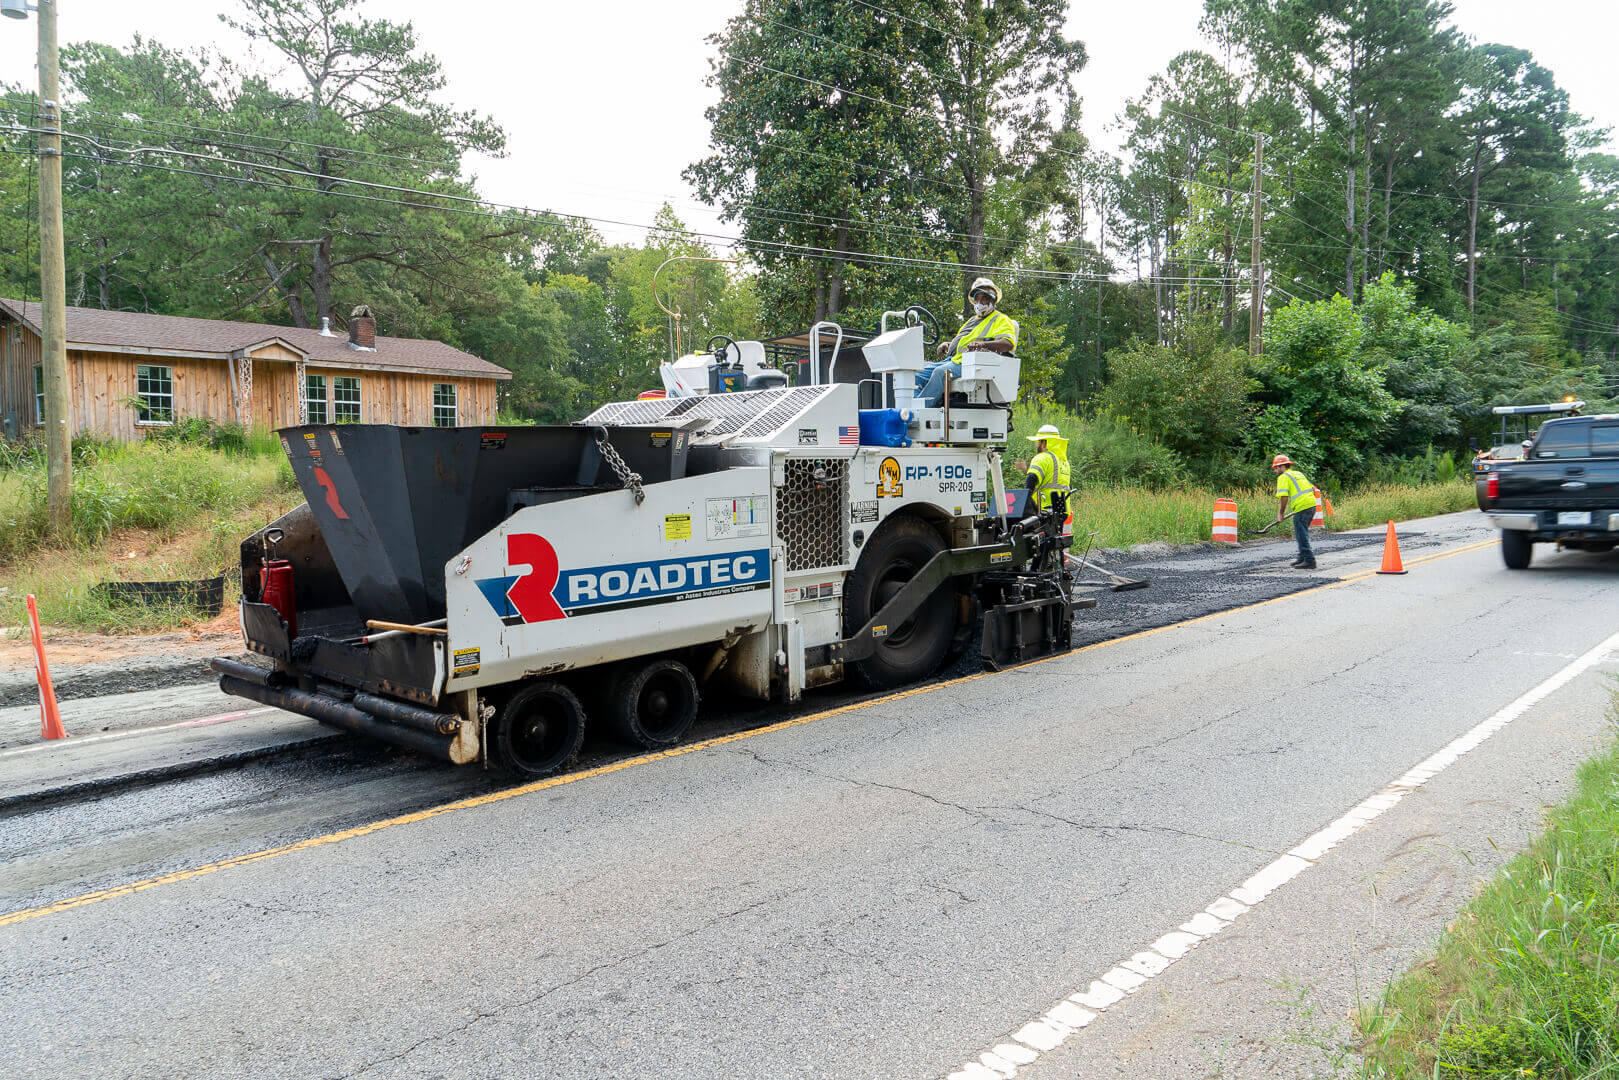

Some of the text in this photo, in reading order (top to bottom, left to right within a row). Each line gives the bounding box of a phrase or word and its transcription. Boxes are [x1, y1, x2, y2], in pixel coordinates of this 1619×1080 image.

[905, 465, 972, 480] RP-190e
[938, 481, 973, 493] SPR-209
[568, 555, 756, 602] ROADTEC
[702, 588, 730, 597] Industries
[731, 585, 755, 593] Company
